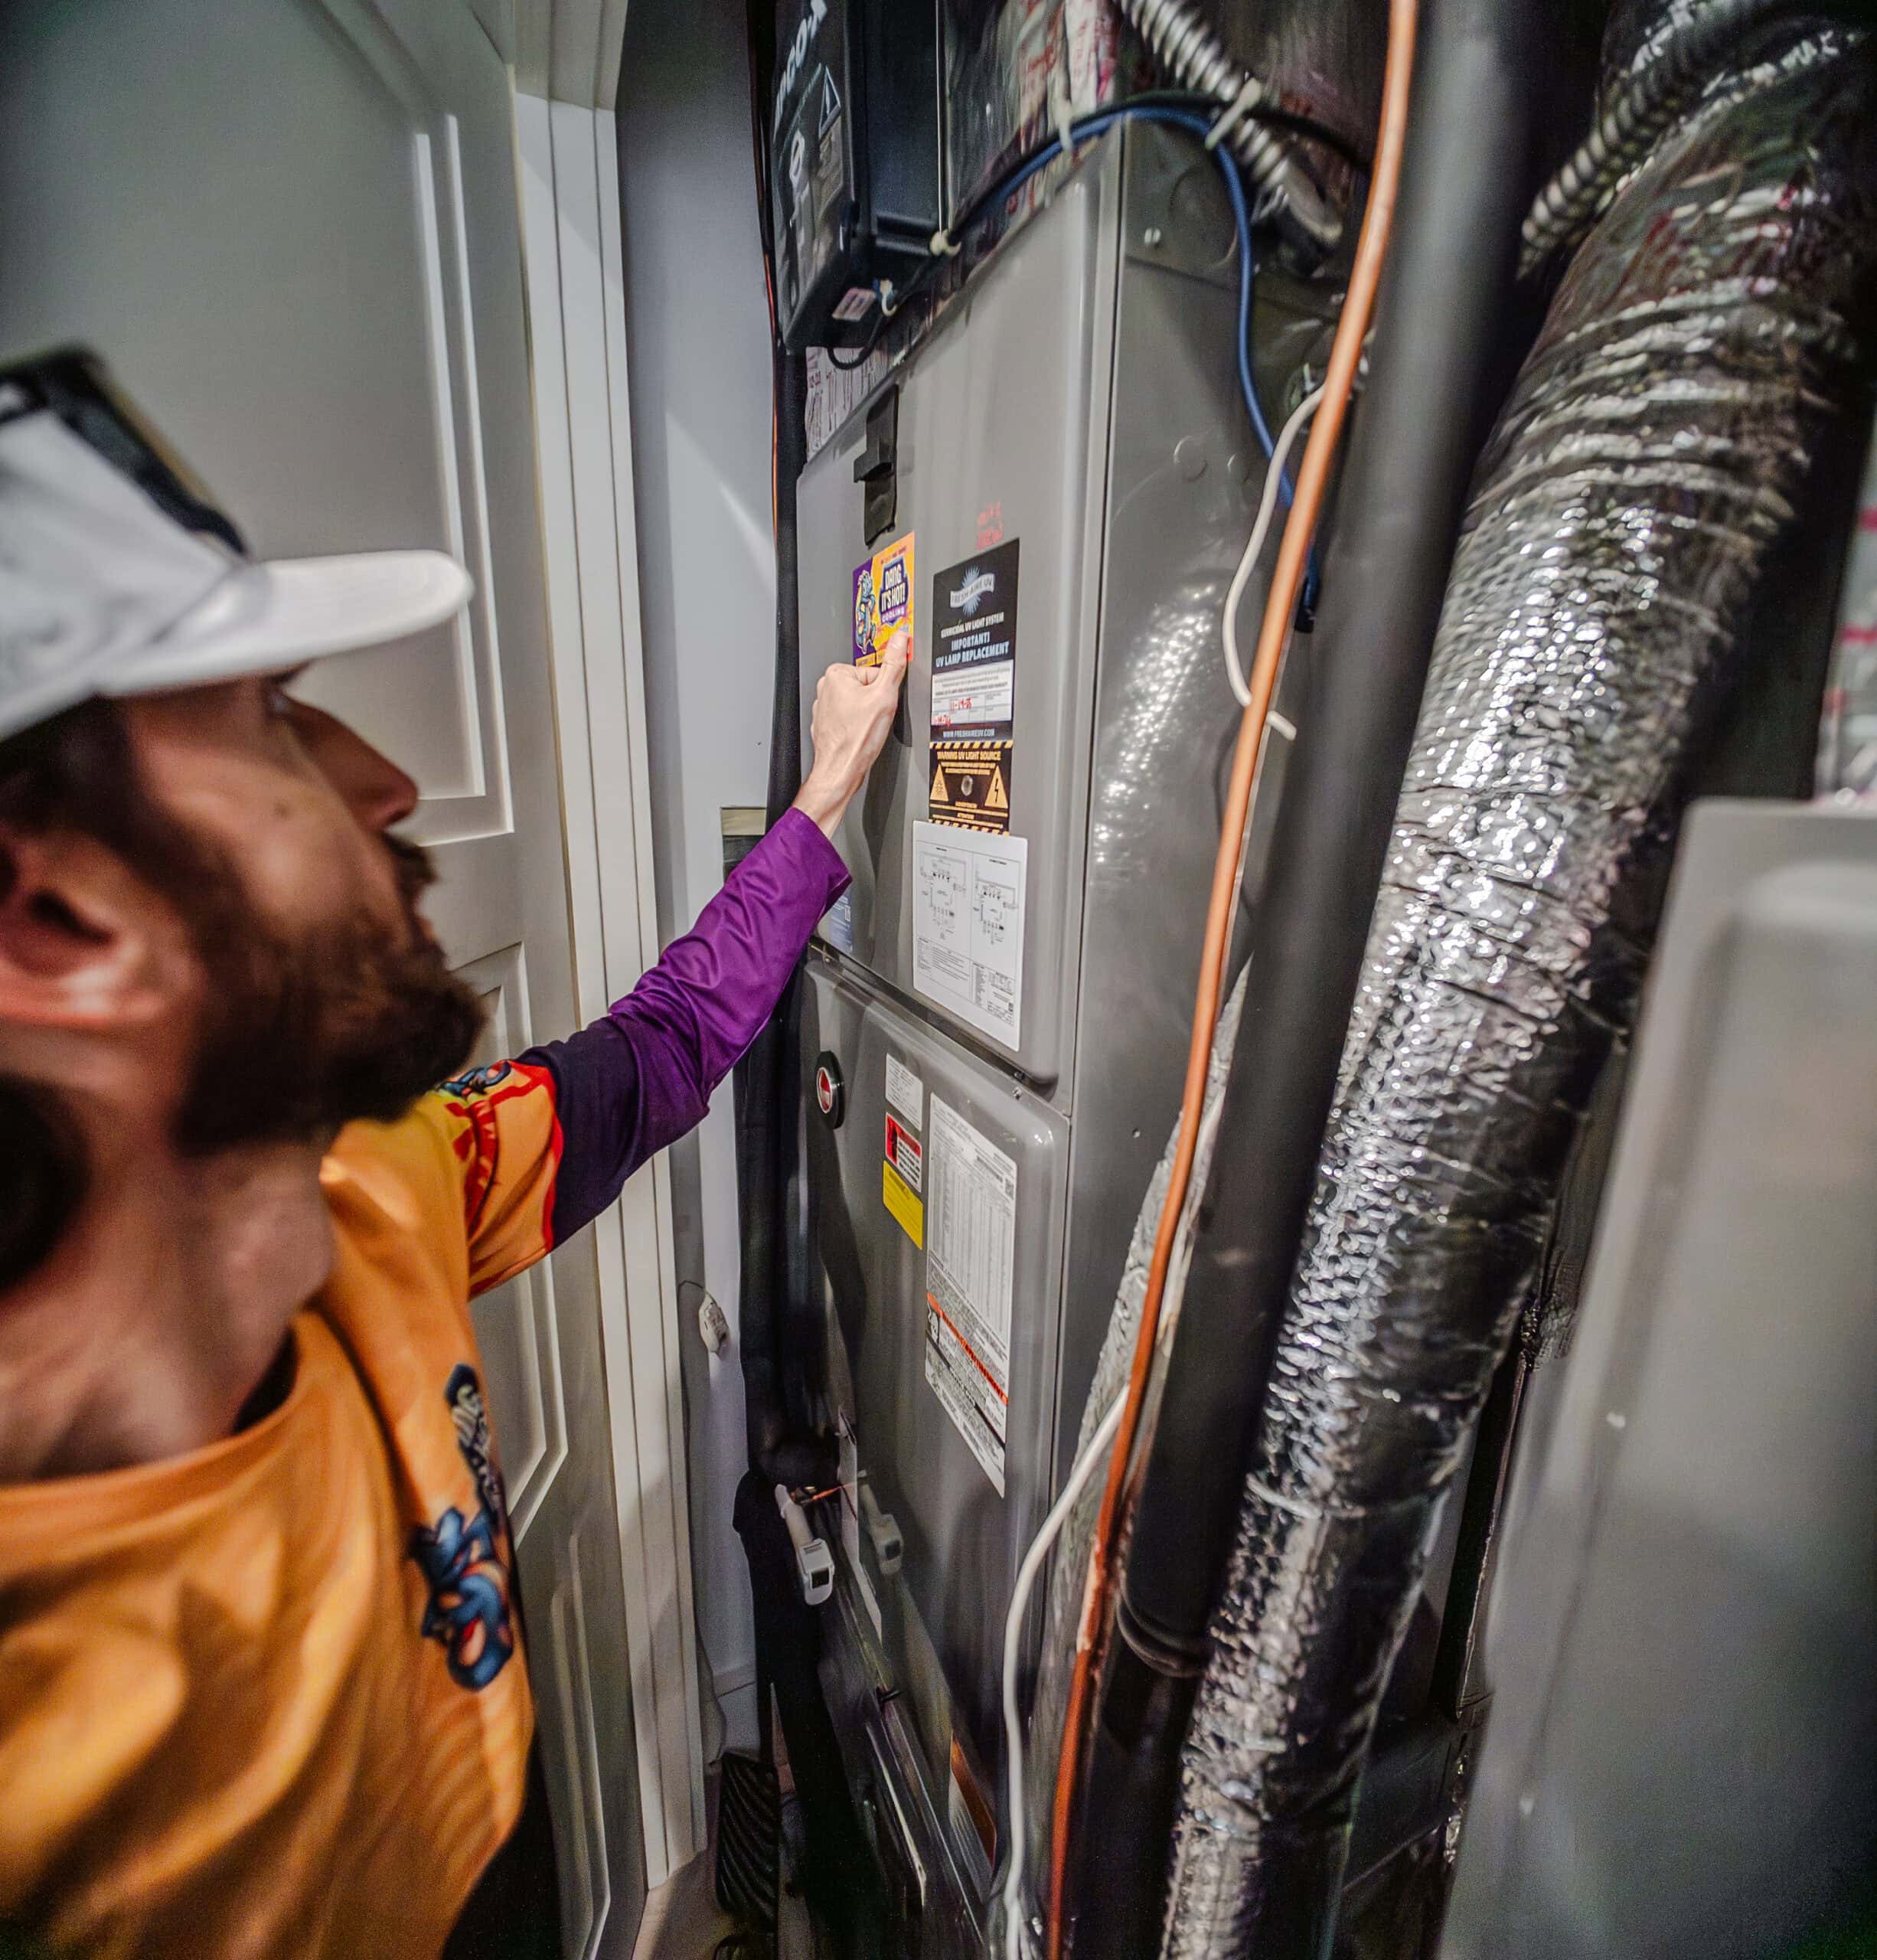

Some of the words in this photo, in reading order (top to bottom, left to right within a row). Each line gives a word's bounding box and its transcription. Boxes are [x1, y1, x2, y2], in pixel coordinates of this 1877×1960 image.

[885, 564, 902, 591] DANG
[881, 590, 892, 612] IT'S
[891, 582, 906, 608] HOT!
[882, 605, 905, 622] COOLING
[971, 617, 985, 630] LIGHT
[985, 612, 1004, 627] SYSTEM
[952, 632, 991, 652] IMPORTANT!
[935, 656, 945, 668] UV
[945, 652, 961, 666] LAMP
[961, 641, 1010, 663] REPLACEMENT
[965, 751, 980, 760] LIGHT
